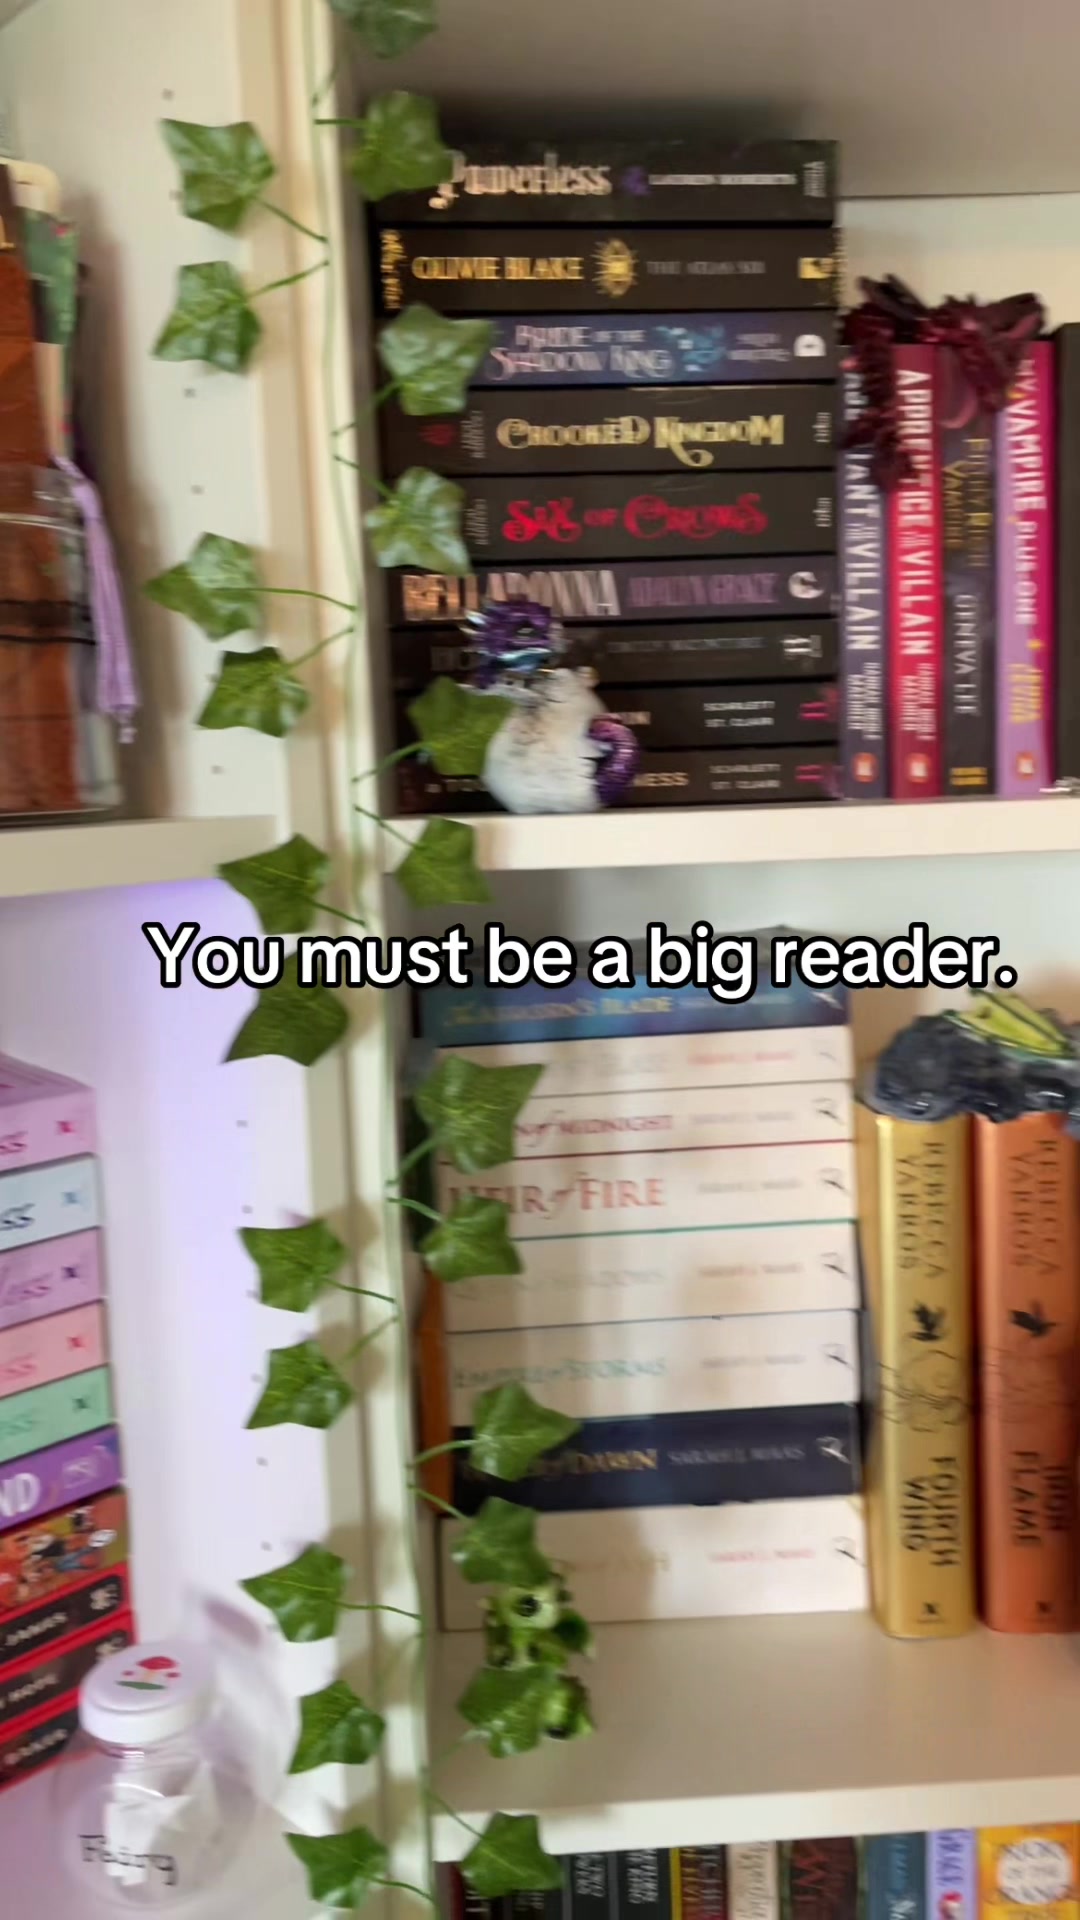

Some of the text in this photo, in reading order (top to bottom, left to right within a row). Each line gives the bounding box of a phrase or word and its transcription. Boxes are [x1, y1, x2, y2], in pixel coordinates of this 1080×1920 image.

[411, 256, 585, 280] OLIVIE BLAKE
[496, 414, 652, 450] CROOKED
[653, 414, 785, 468] KINGDOM
[1005, 399, 1048, 512] VAMPIRE
[502, 497, 583, 543] SIX
[622, 492, 769, 541] CROWS
[845, 542, 881, 650] VILLAIN
[898, 550, 935, 656] VILLAIN
[952, 594, 980, 716] GENEVA LEE
[576, 1177, 666, 1211] FIRE
[899, 1476, 930, 1552] WING
[928, 1455, 960, 1568] FOURTH
[1010, 1450, 1042, 1549] FLAME
